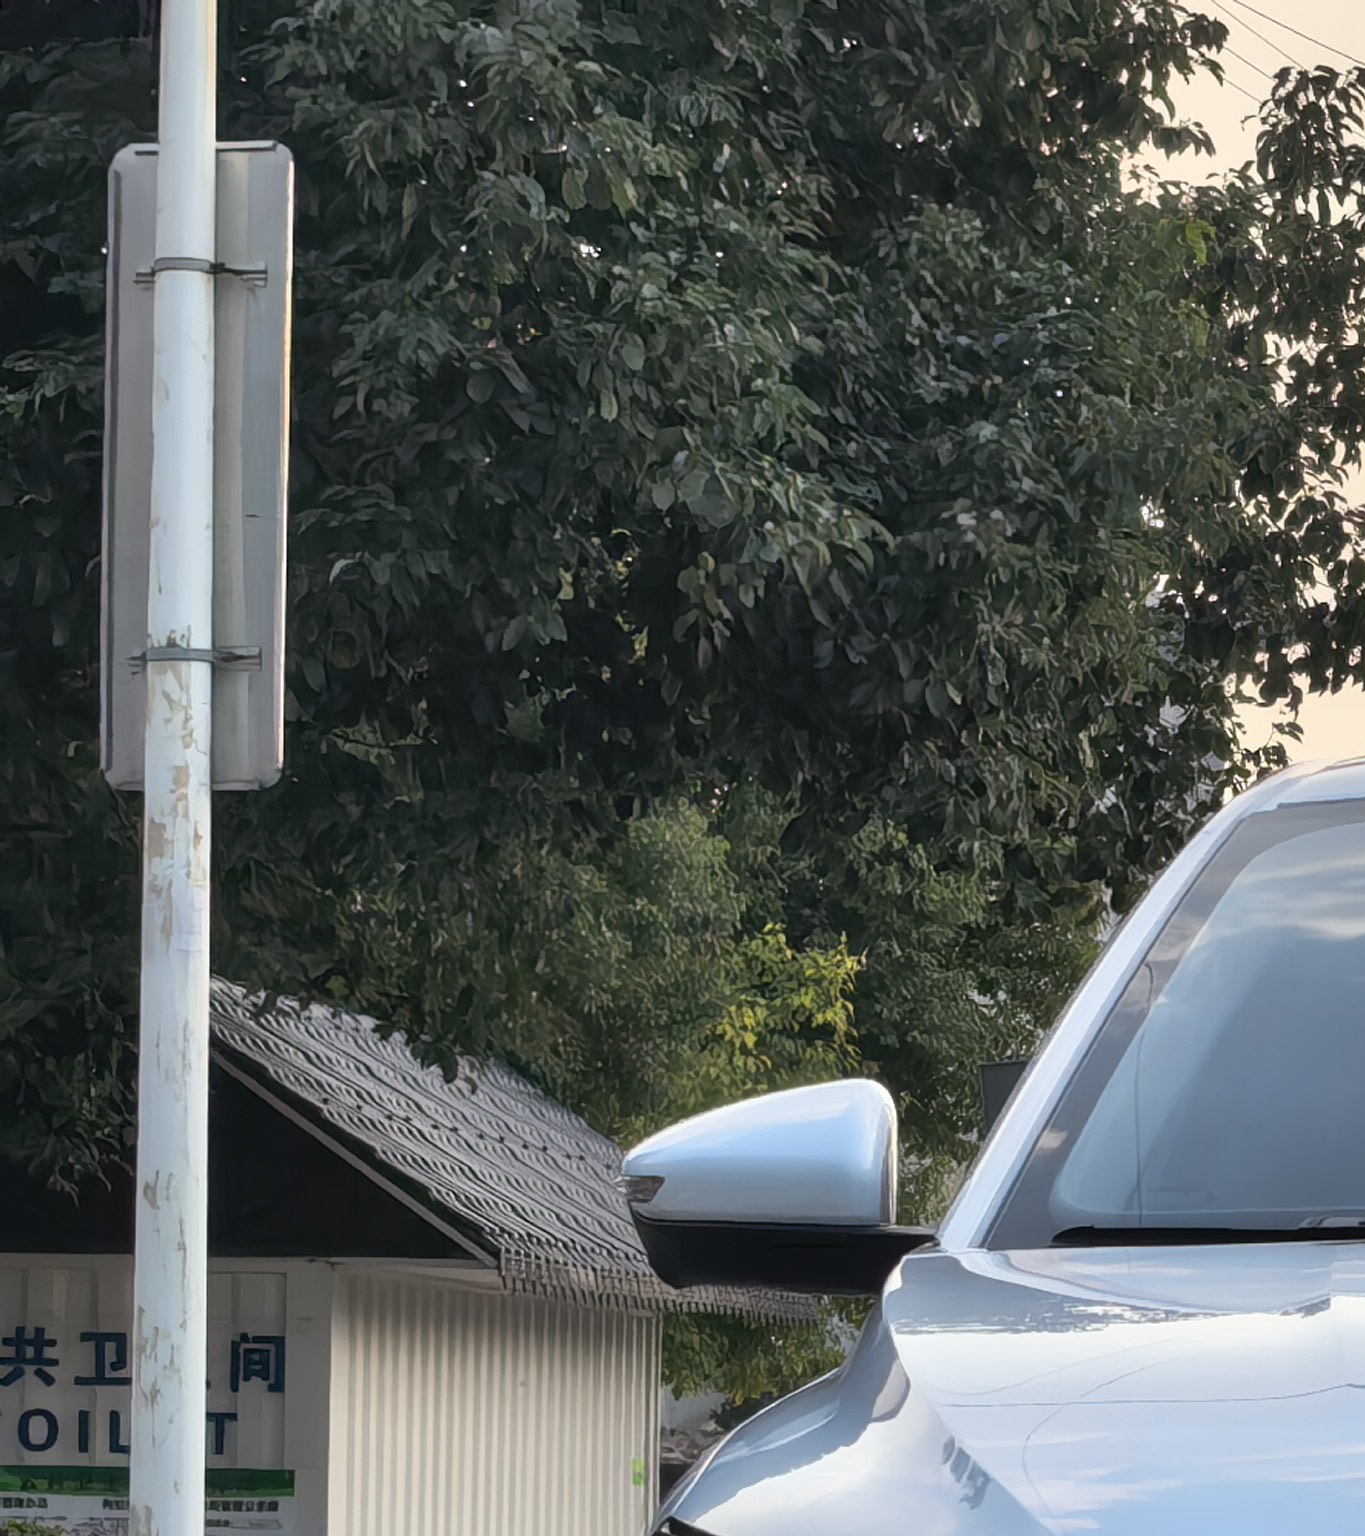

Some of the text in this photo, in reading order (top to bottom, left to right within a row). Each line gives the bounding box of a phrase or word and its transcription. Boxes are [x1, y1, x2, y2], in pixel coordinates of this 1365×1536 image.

[0, 1326, 285, 1393] 共卫间
[0, 1408, 238, 1455] OILT
